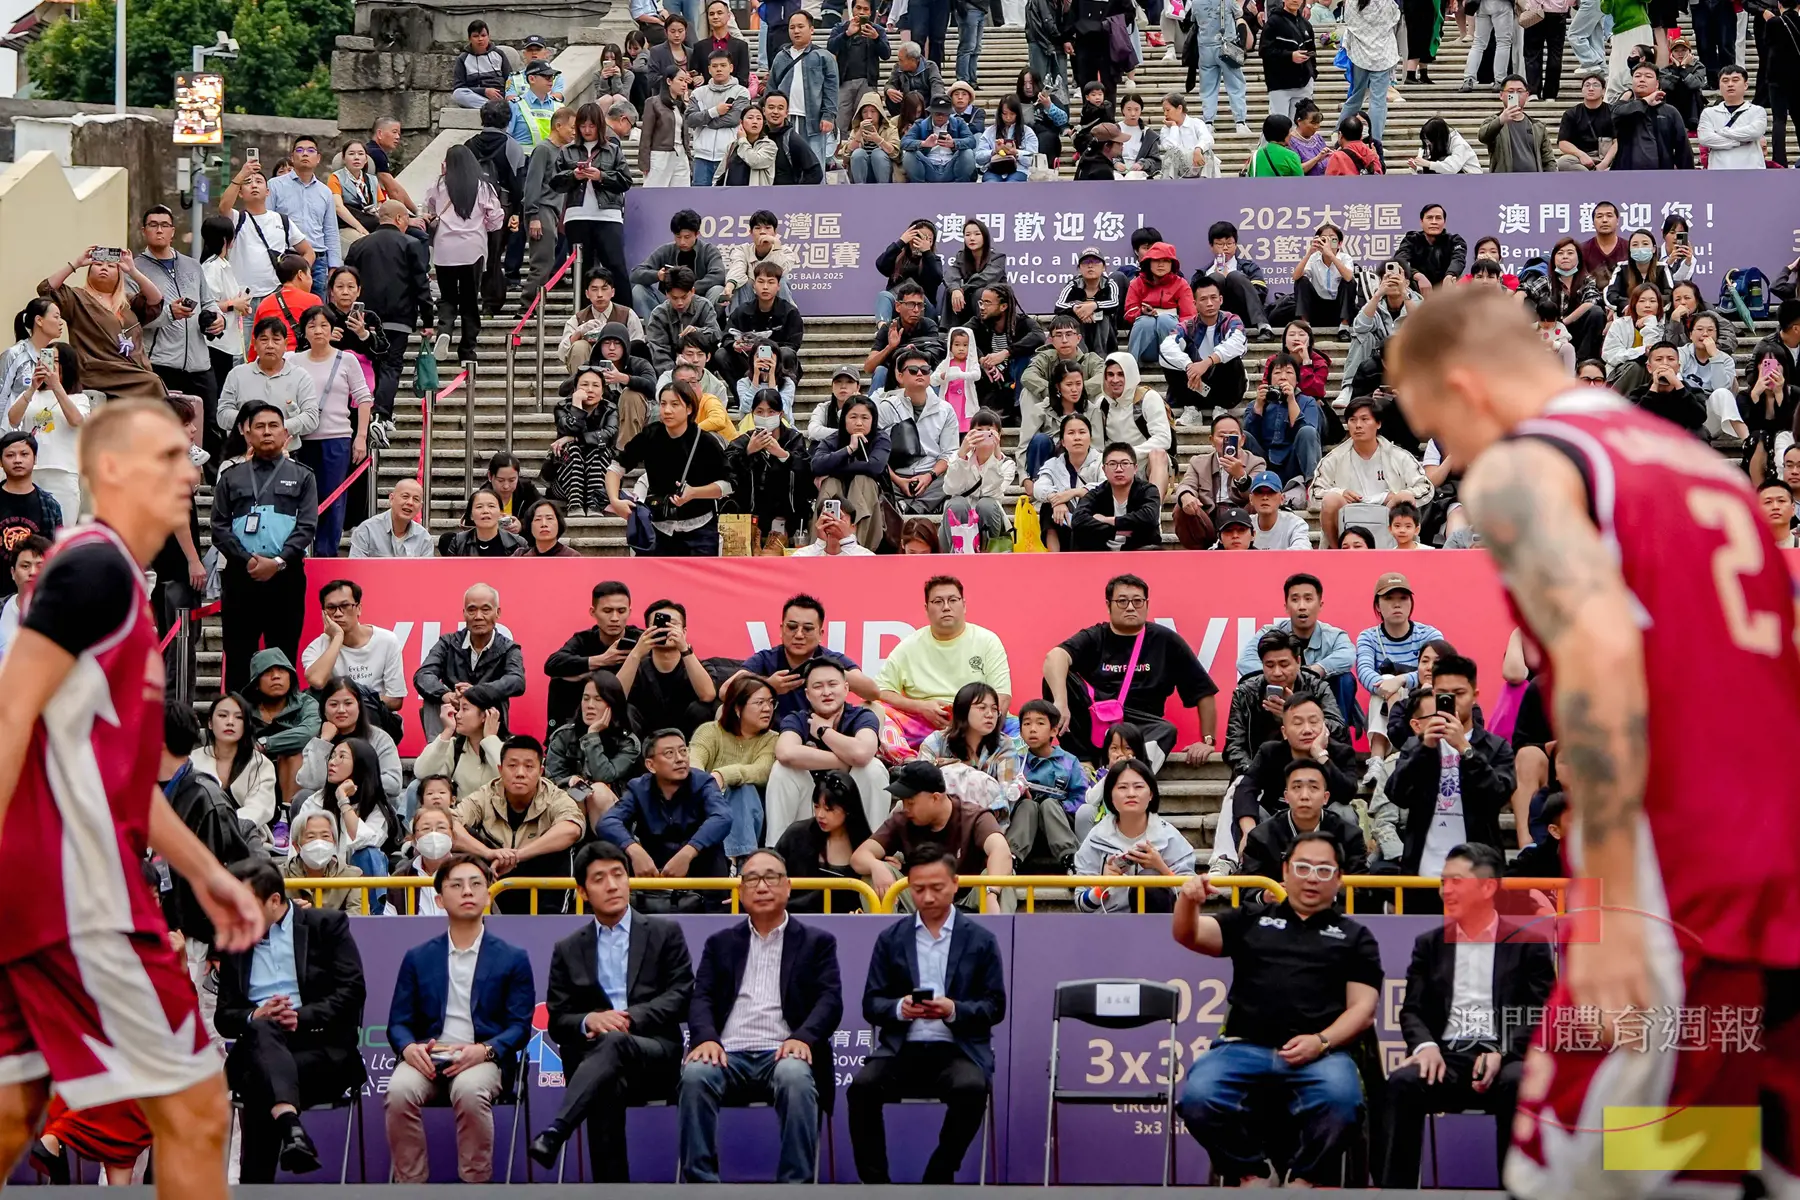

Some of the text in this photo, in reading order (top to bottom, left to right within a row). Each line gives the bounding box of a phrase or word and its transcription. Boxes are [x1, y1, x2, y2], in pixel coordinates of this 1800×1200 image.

[1239, 203, 1403, 231] 2025大灣區
[701, 213, 842, 240] 025灣區
[1051, 255, 1061, 266] a
[823, 272, 844, 280] 2025
[1005, 271, 1074, 284] Welcom
[812, 282, 832, 290] 2025
[1686, 486, 1783, 659] 2
[833, 1030, 872, 1048] 育局
[1134, 1120, 1163, 1135] 3x3
